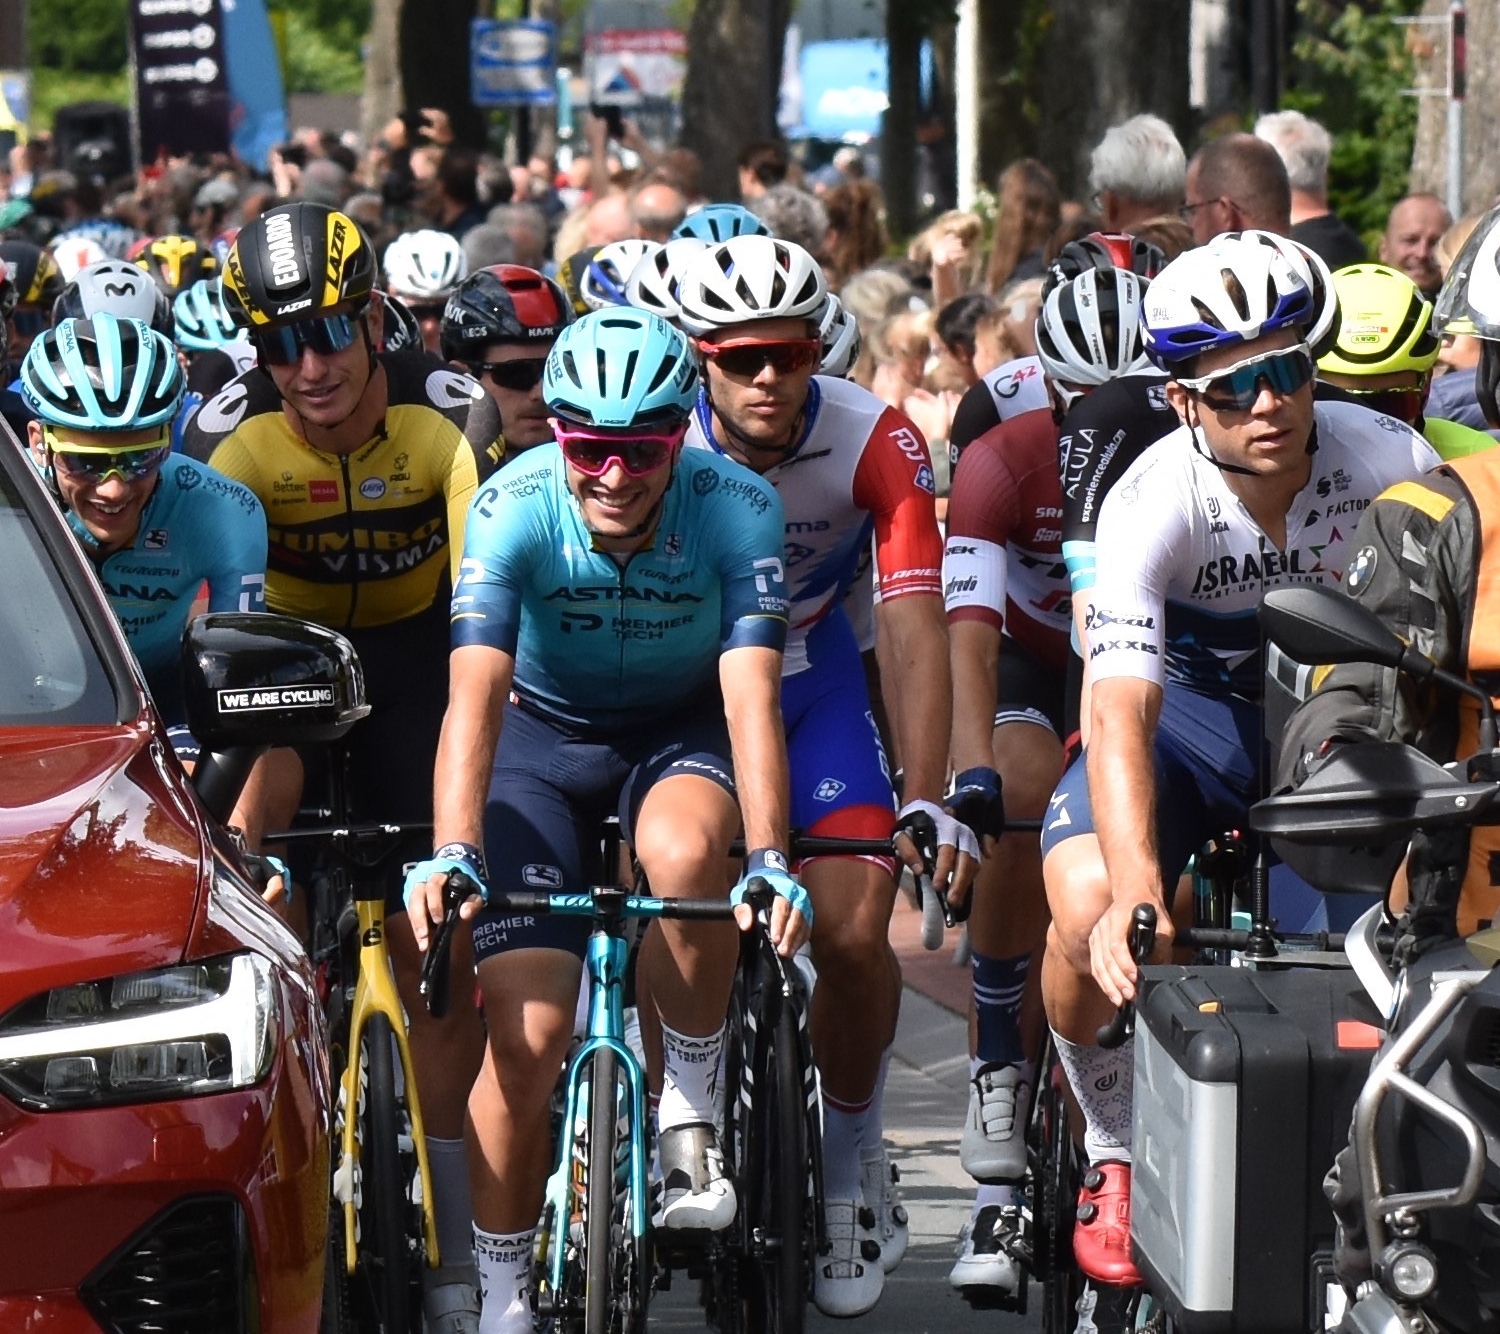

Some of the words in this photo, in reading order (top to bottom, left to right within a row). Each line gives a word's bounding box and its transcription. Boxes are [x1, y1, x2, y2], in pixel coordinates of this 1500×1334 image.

[265, 213, 300, 286] EDOARDO
[327, 220, 348, 291] LAZER
[277, 298, 312, 315] LAZER
[1066, 428, 1099, 500] ALULA
[502, 468, 553, 491] PREMIER
[508, 484, 542, 501] TECH
[321, 534, 444, 573] VISMA
[1192, 549, 1307, 595] ISRAEL
[544, 586, 704, 603] ASTANA
[611, 614, 695, 631] PREMIER
[612, 628, 665, 640] TECH
[224, 693, 249, 707] WE
[251, 691, 280, 705] ARE
[282, 689, 331, 703] CYCLING
[472, 915, 536, 941] PREMIER
[474, 930, 508, 952] TECH
